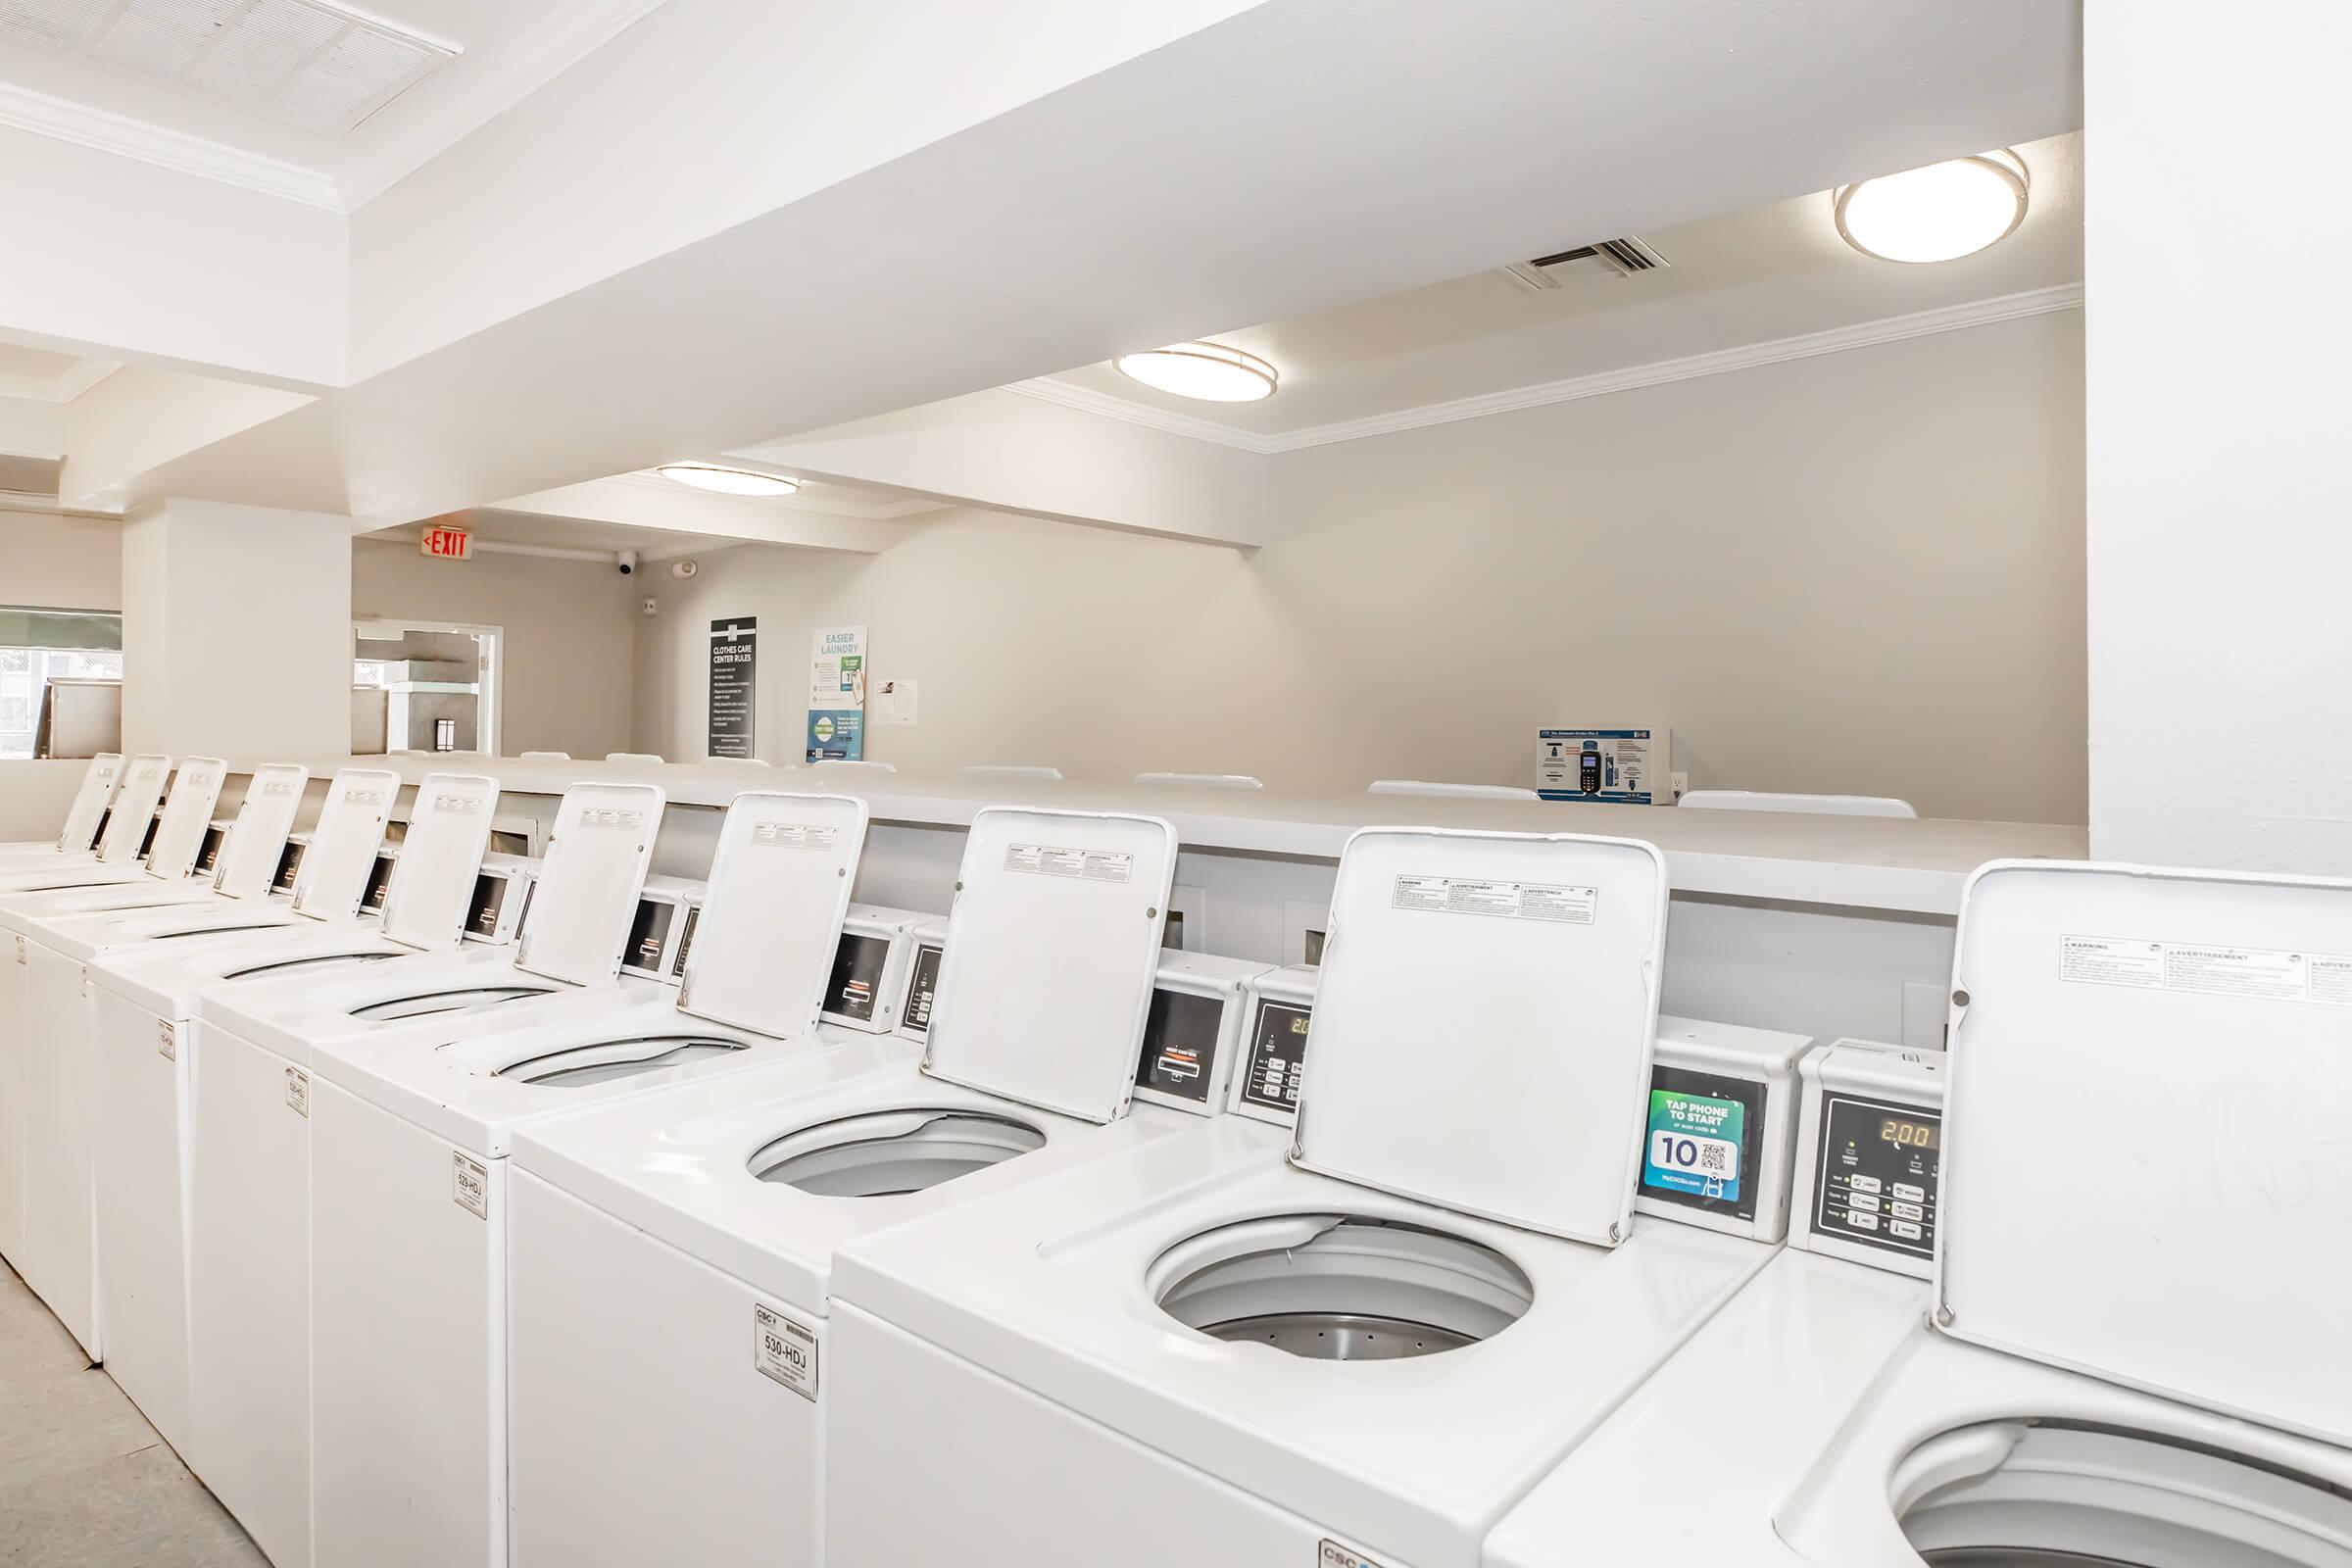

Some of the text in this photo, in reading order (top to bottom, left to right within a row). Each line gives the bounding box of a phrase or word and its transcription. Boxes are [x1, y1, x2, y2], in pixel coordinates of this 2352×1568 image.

[431, 530, 467, 557] EXIT
[826, 633, 855, 644] EASIER
[713, 644, 752, 655] CLOTHES CARE
[821, 644, 858, 655] LAUNDRY
[713, 654, 752, 663] CENTER RULES
[2071, 942, 2109, 951] WARNING
[1666, 1100, 1729, 1117] TAP PHONE
[1670, 1109, 1723, 1126] TO START
[1881, 1121, 1930, 1147] 2.00
[1662, 1137, 1697, 1166] 10
[764, 1335, 807, 1368] 530-HDJ
[1324, 1547, 1356, 1568] CSC
